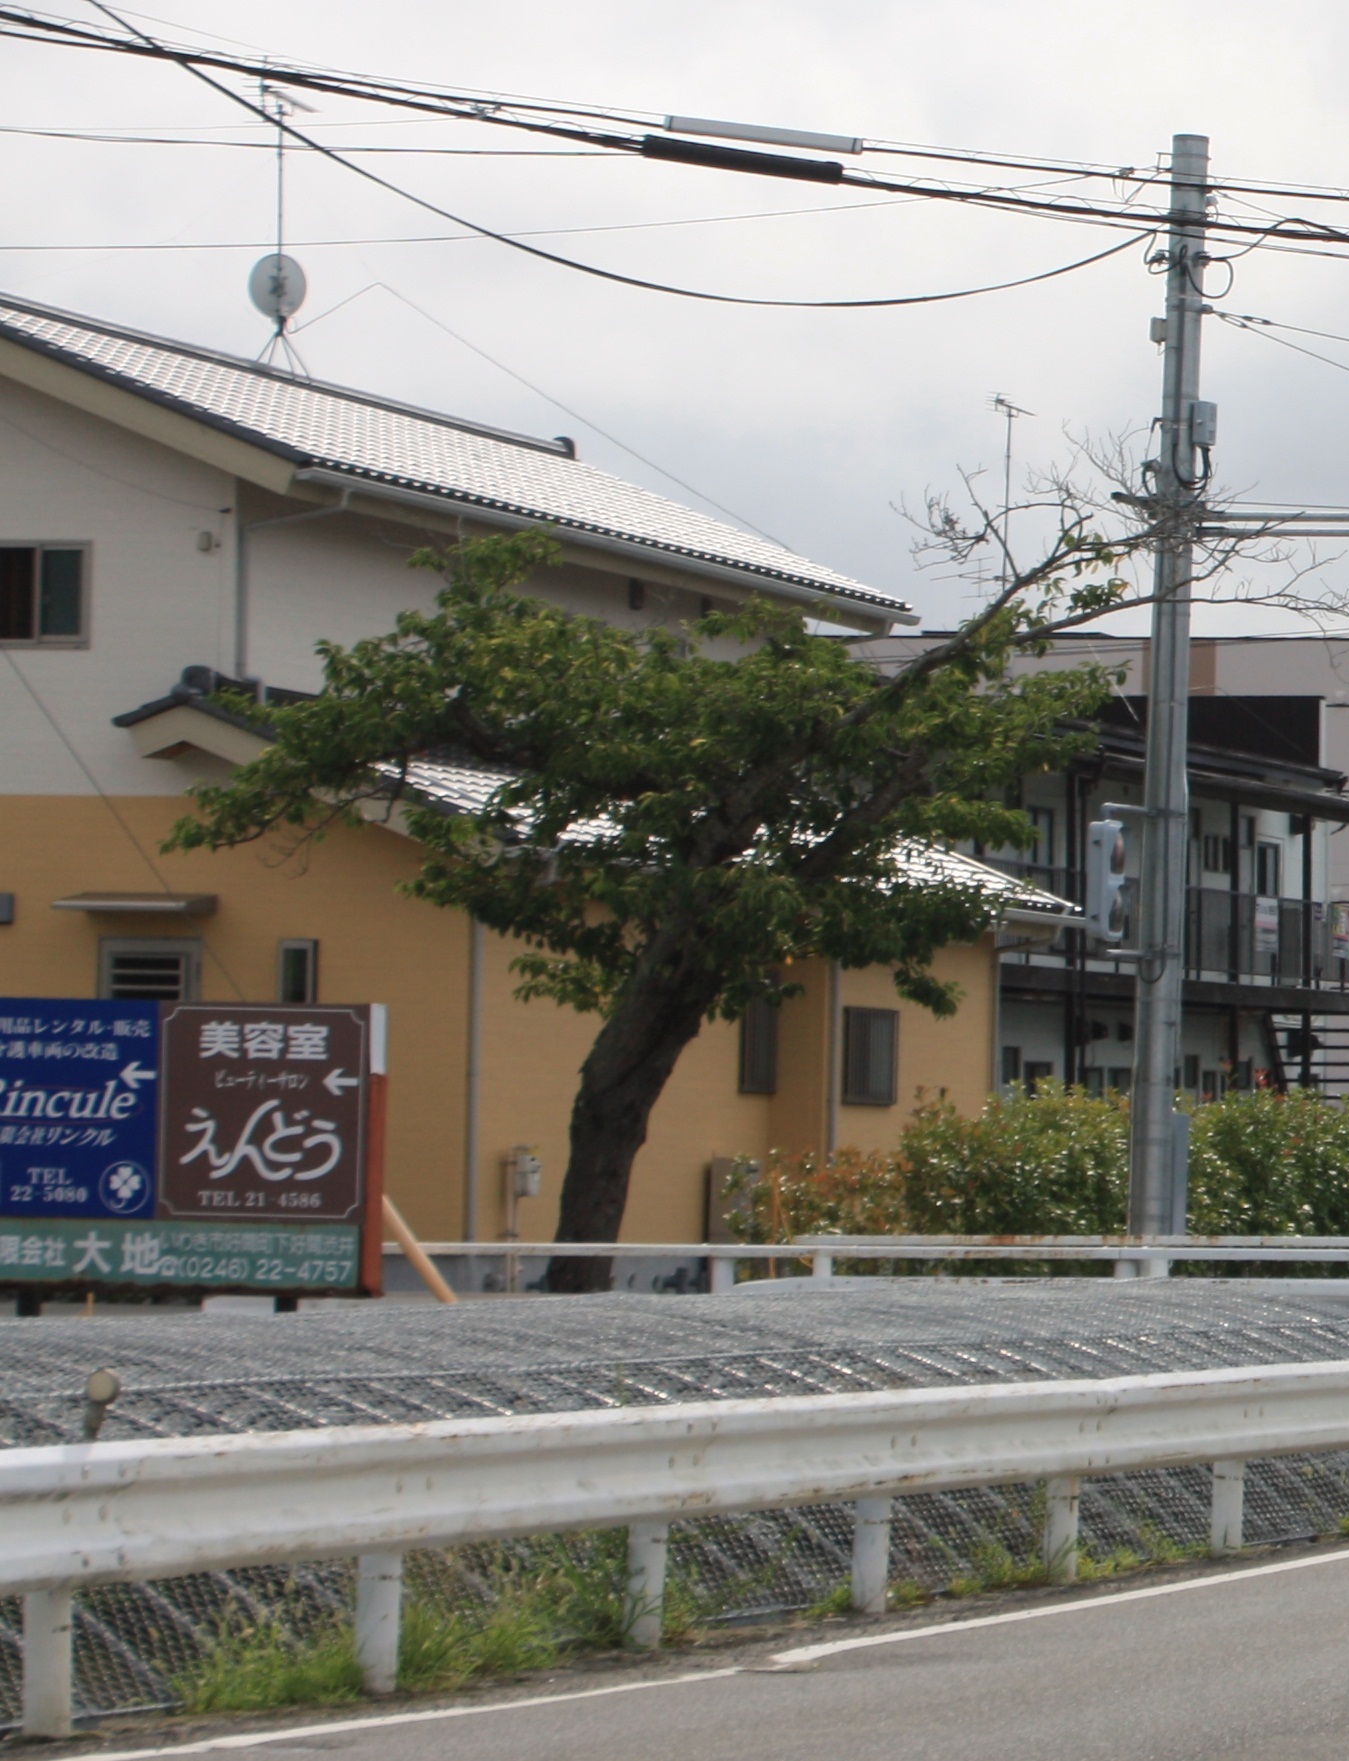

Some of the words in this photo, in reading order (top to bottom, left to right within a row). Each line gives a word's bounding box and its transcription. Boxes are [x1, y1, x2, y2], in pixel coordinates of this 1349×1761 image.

[199, 1020, 329, 1060] 美容室
[179, 1099, 342, 1181] えんどう
[27, 1166, 74, 1185] TEL
[198, 1190, 239, 1207] TEL
[254, 1259, 352, 1283] 22-4757
